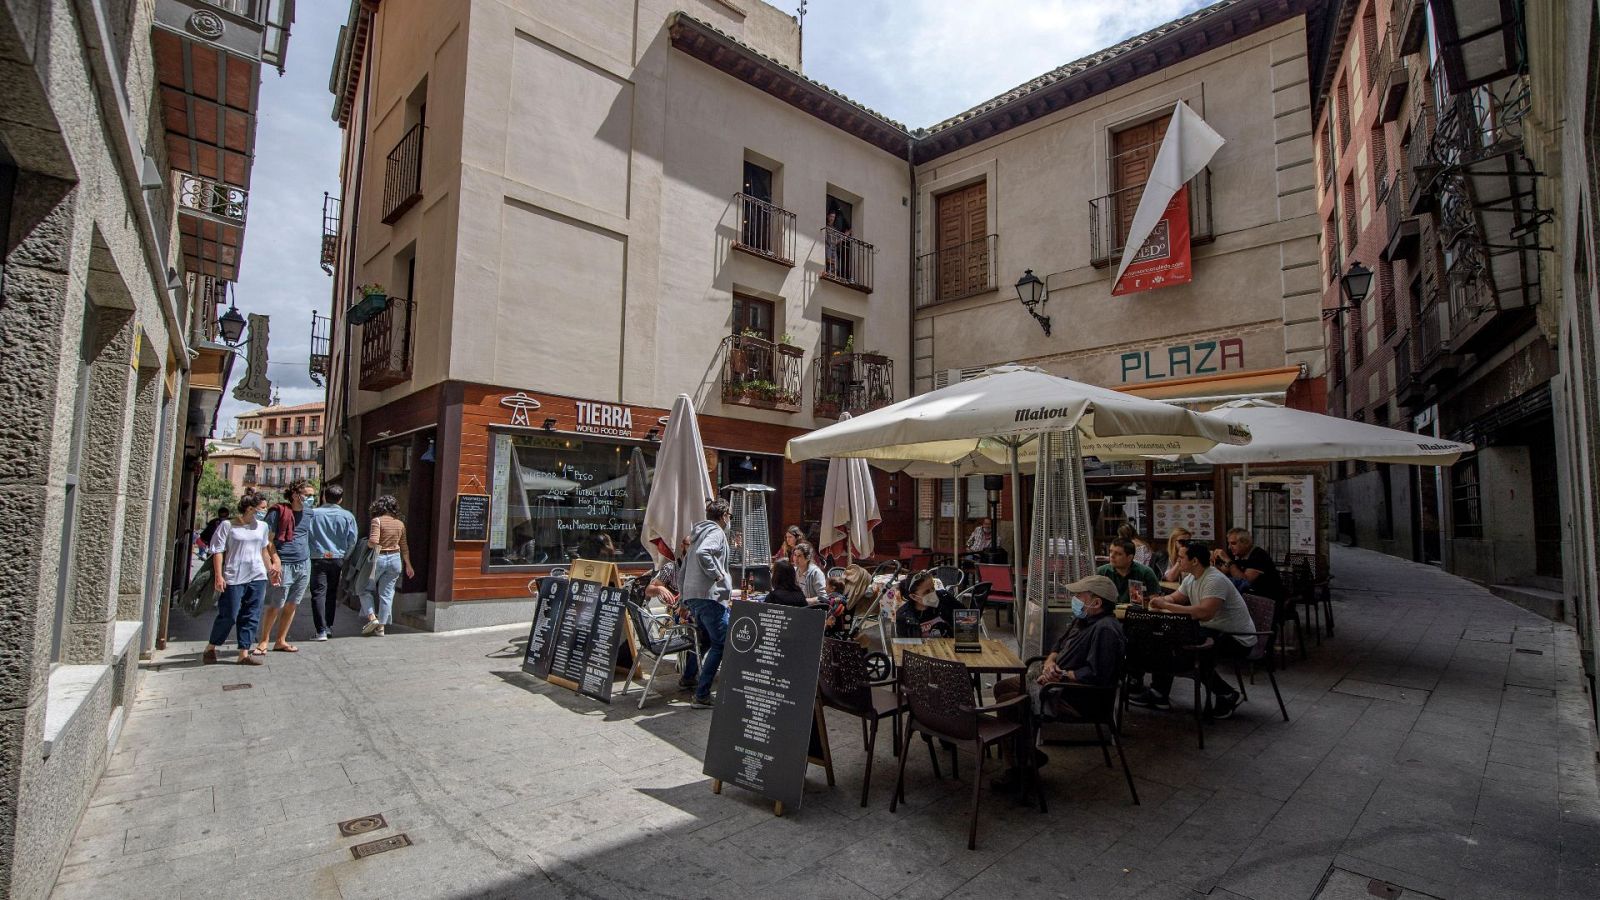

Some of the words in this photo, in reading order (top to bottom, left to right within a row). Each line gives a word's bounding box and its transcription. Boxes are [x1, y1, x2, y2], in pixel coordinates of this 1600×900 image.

[1121, 338, 1244, 382] PLAZA
[240, 391, 268, 399] ZOCO
[576, 401, 632, 429] TIERRA
[1014, 406, 1068, 423] Mahou
[576, 424, 599, 433] WORLD
[601, 427, 618, 435] FOOD
[619, 429, 632, 437] BAR
[574, 470, 594, 480] PISO
[608, 518, 637, 531] SEVILLA
